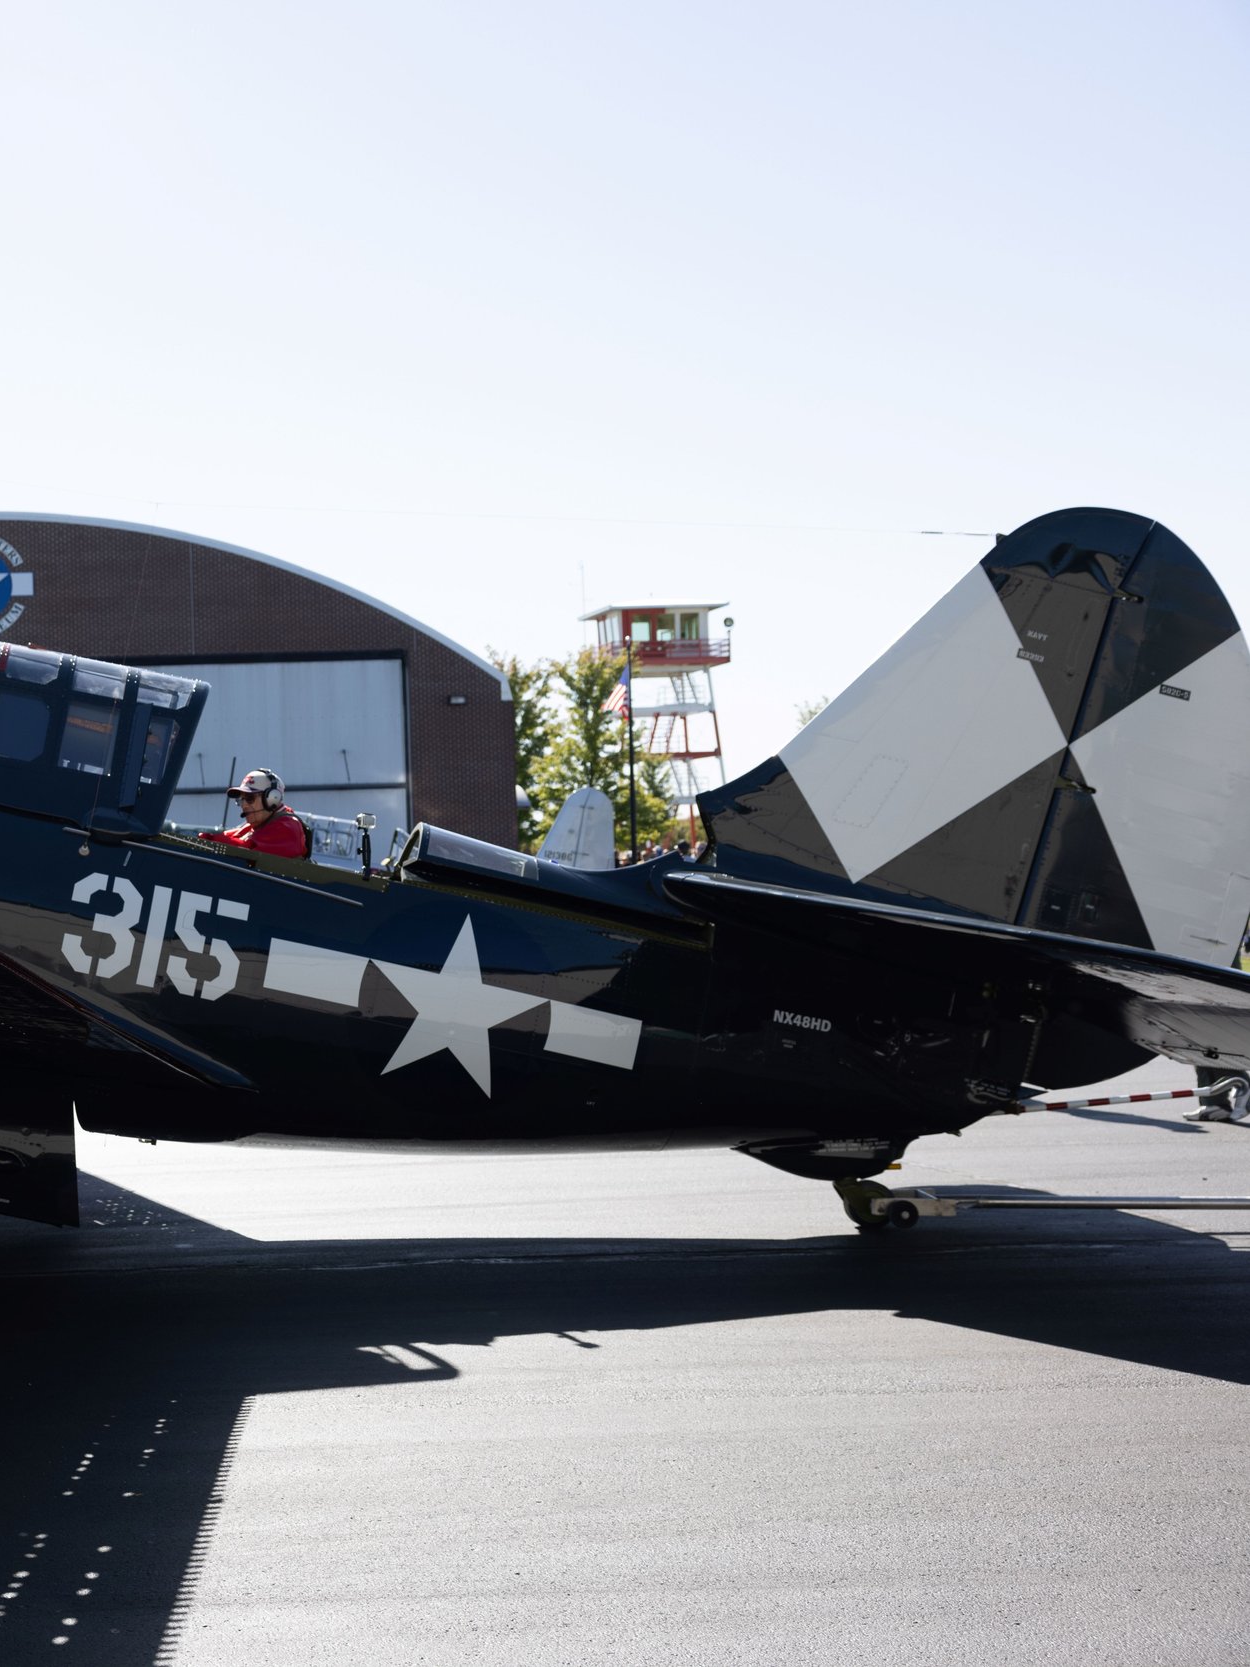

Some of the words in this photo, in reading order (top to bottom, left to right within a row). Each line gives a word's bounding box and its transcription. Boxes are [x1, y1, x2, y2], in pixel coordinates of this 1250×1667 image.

[1027, 629, 1049, 641] NAVY
[60, 872, 251, 1002] 315
[773, 1009, 832, 1033] NX48HD
